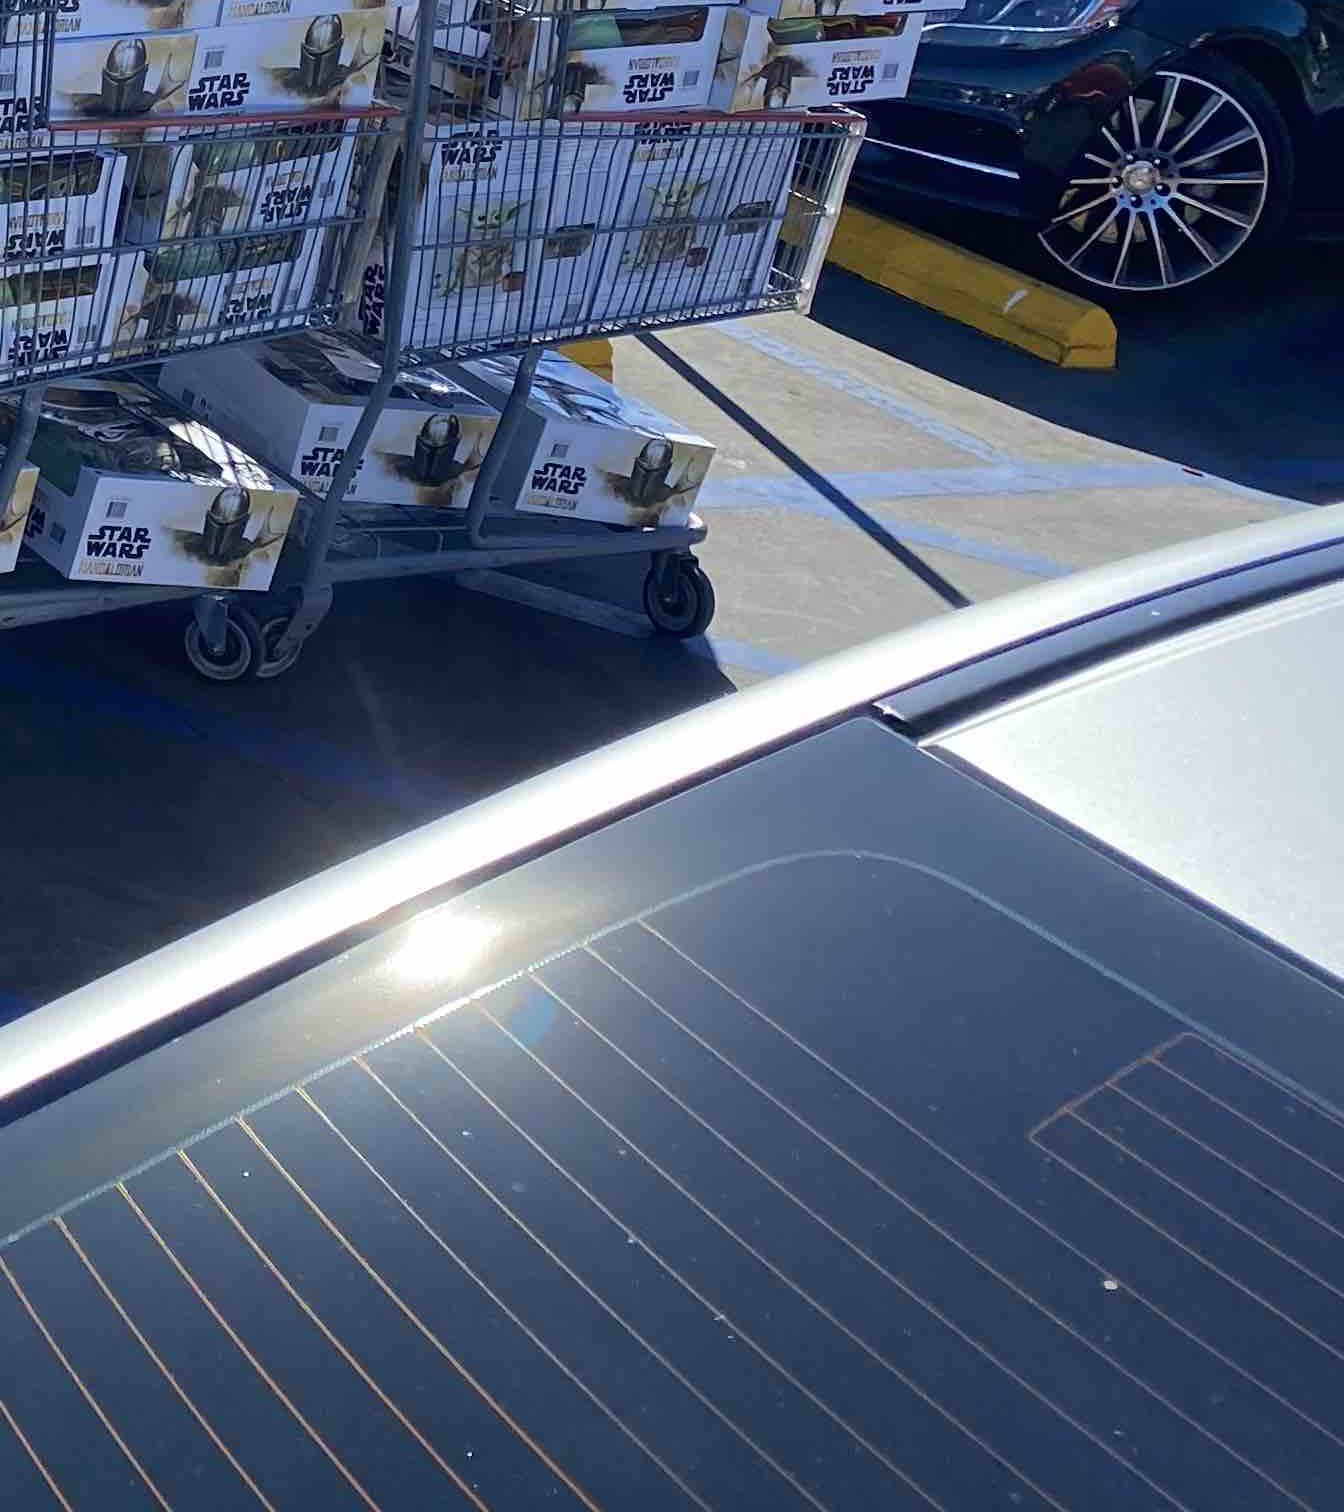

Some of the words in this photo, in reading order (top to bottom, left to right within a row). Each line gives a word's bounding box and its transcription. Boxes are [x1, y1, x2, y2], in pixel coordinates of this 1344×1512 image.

[189, 72, 250, 94] STAR
[625, 73, 674, 88] WARS
[828, 65, 874, 82] WARS
[624, 87, 673, 103] STAR
[827, 80, 873, 95] STAR
[188, 90, 249, 111] WARS
[534, 462, 587, 481] STAR
[531, 476, 585, 495] WARS
[89, 525, 152, 544] STAR
[85, 540, 149, 560] WARS
